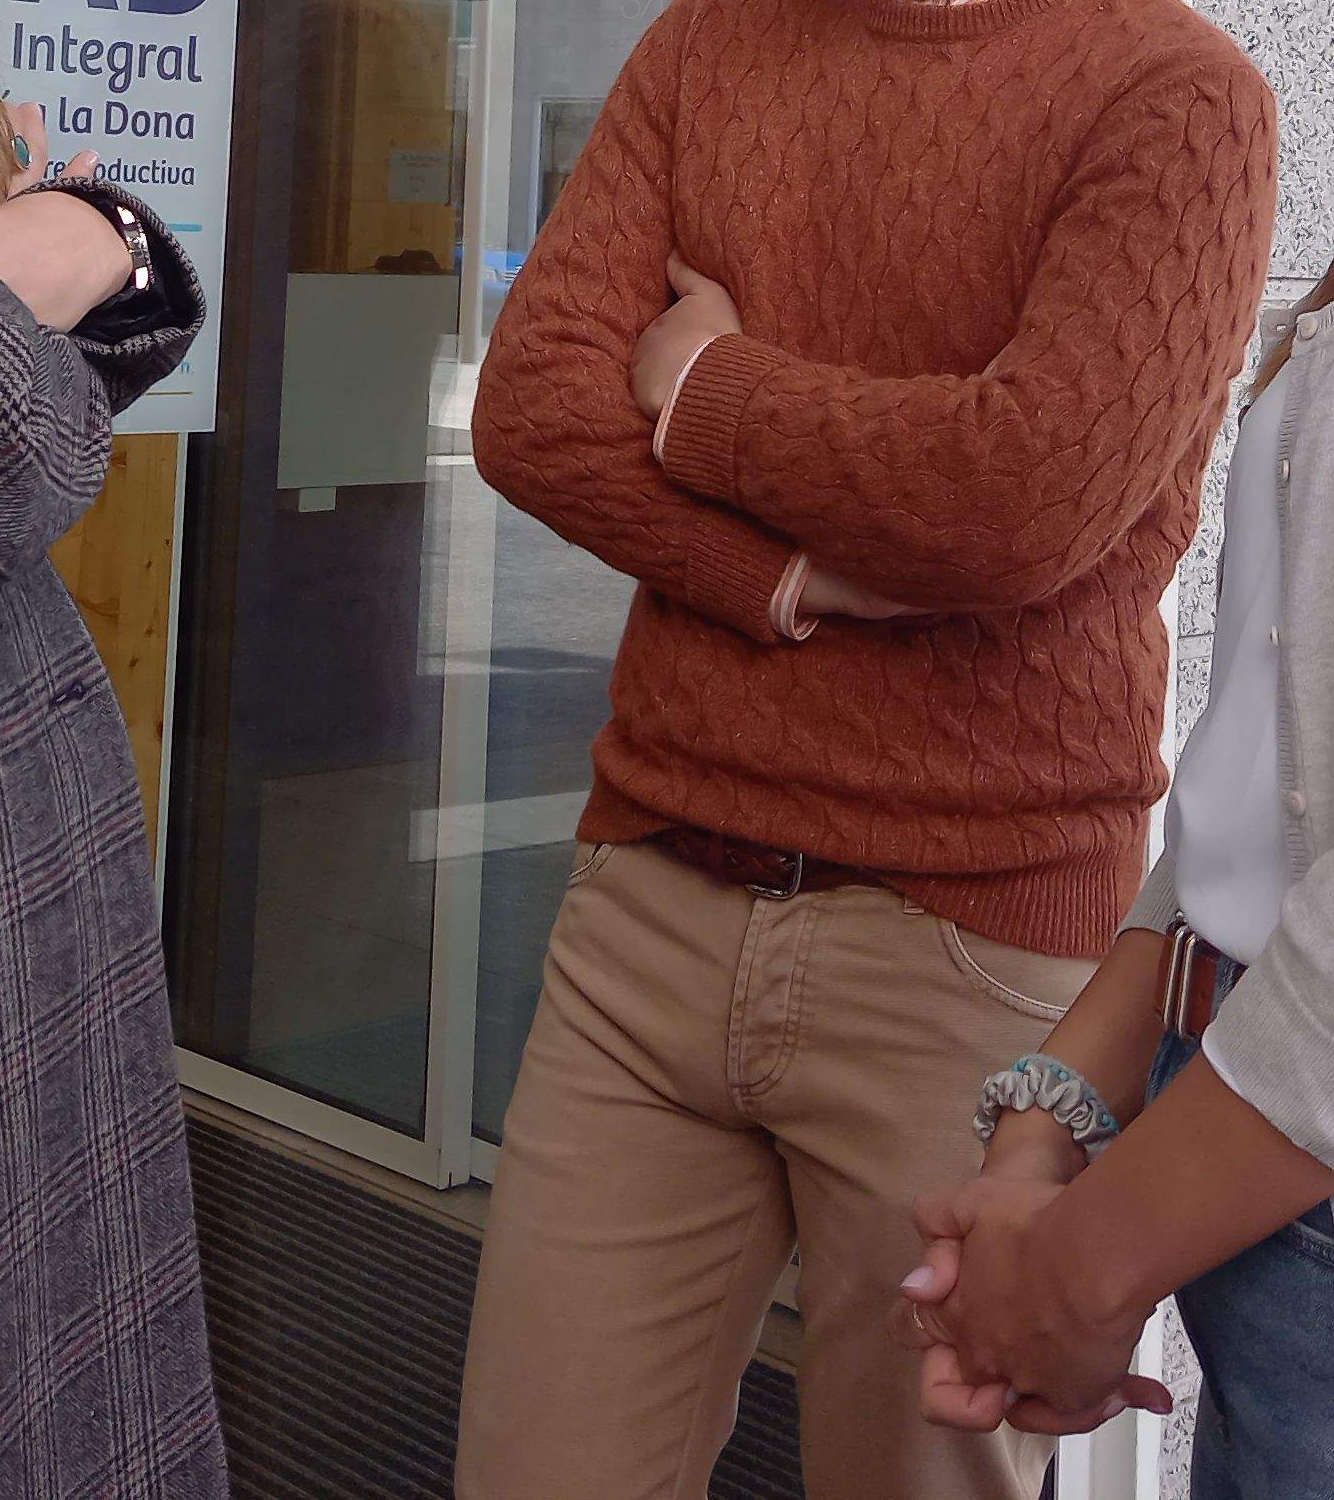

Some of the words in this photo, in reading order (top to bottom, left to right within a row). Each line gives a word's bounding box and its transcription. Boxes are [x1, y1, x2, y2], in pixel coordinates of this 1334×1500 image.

[12, 22, 203, 94] Integral
[59, 97, 93, 134] la
[104, 100, 195, 140] Dona
[44, 157, 196, 187] reoductiva
